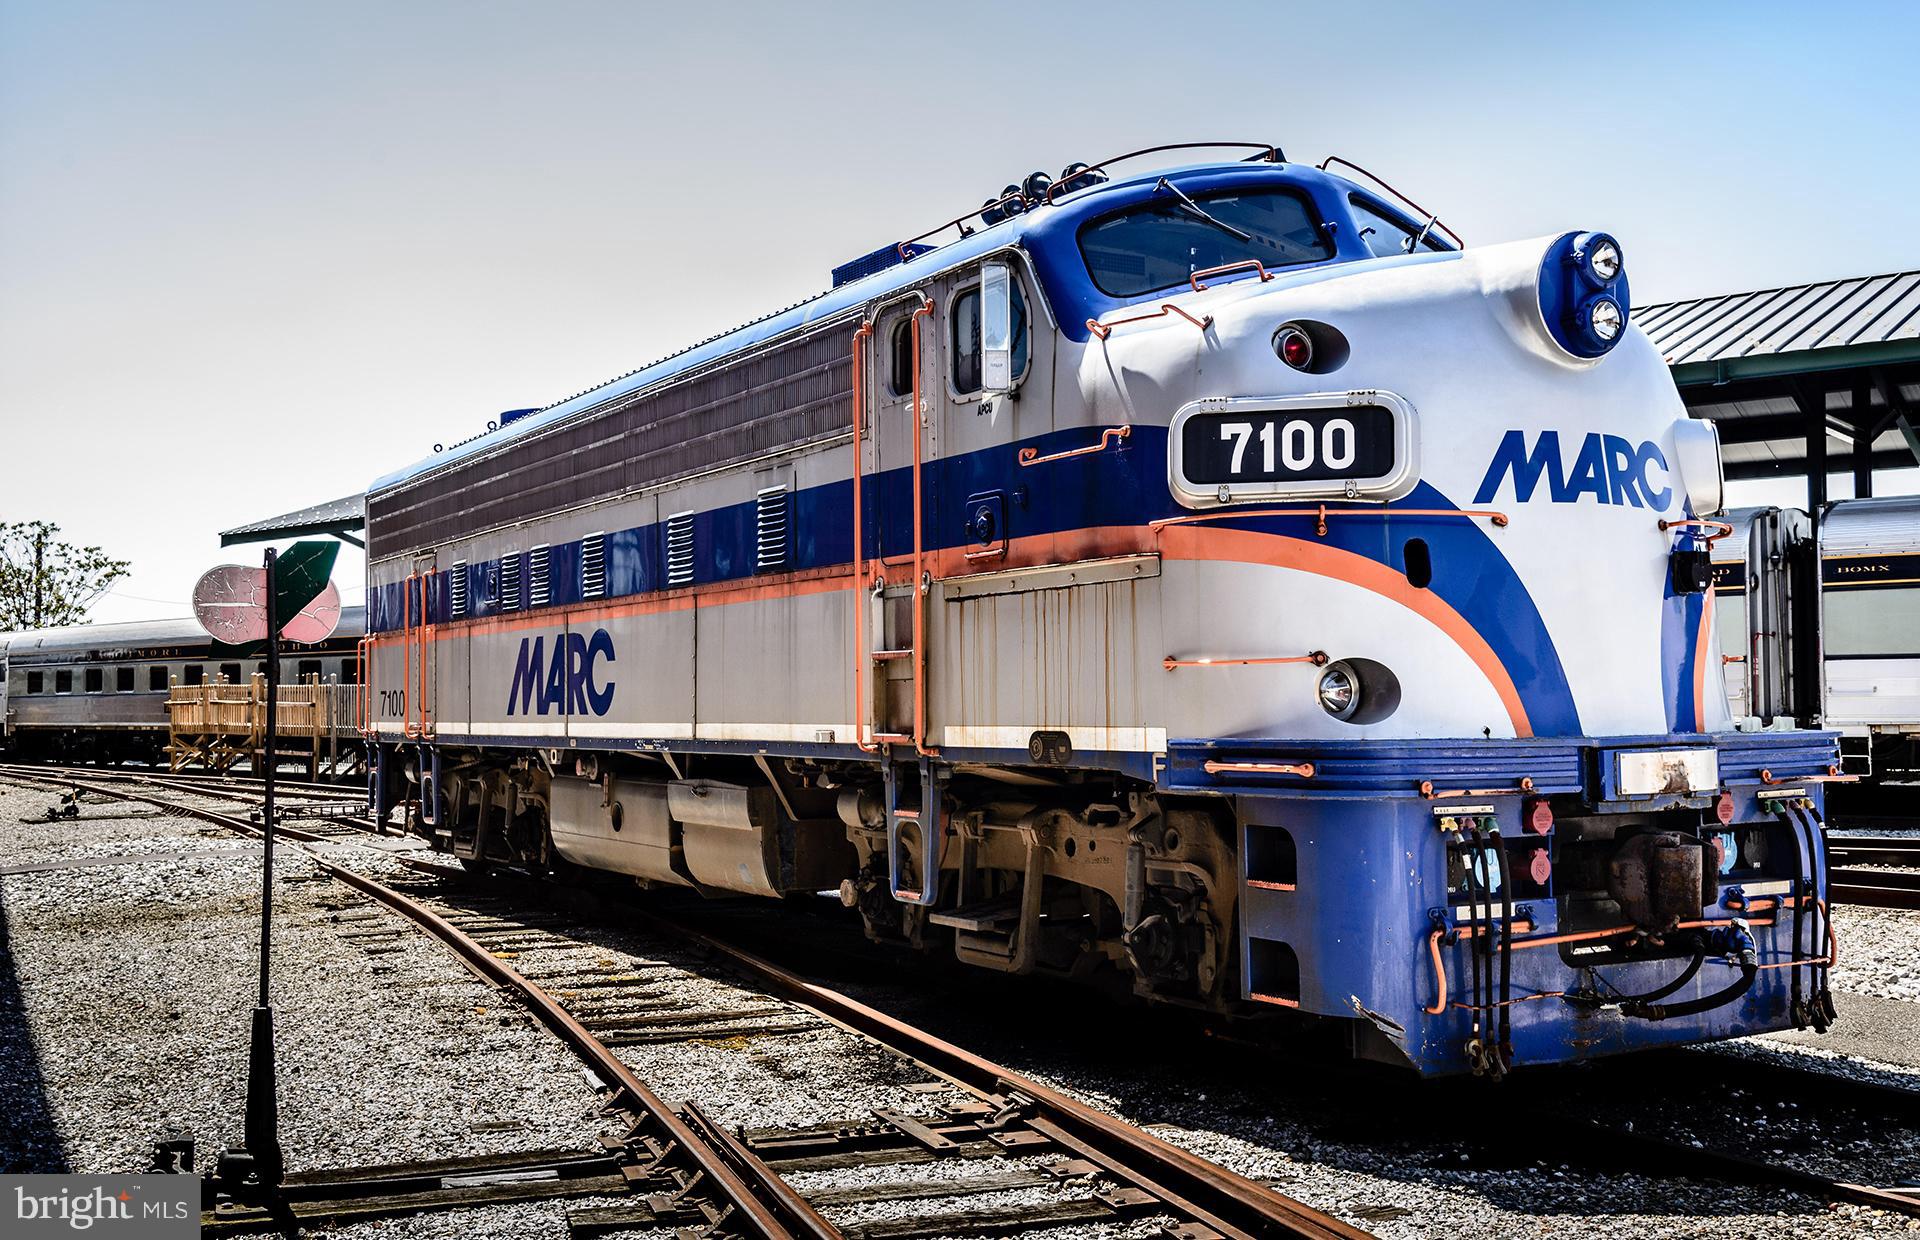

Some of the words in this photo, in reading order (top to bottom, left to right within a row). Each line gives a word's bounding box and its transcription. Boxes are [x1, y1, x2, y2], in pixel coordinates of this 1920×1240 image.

[1220, 418, 1356, 474] 7100
[1472, 430, 1673, 513] MARC
[380, 689, 405, 717] 7100
[506, 628, 616, 717] MARC
